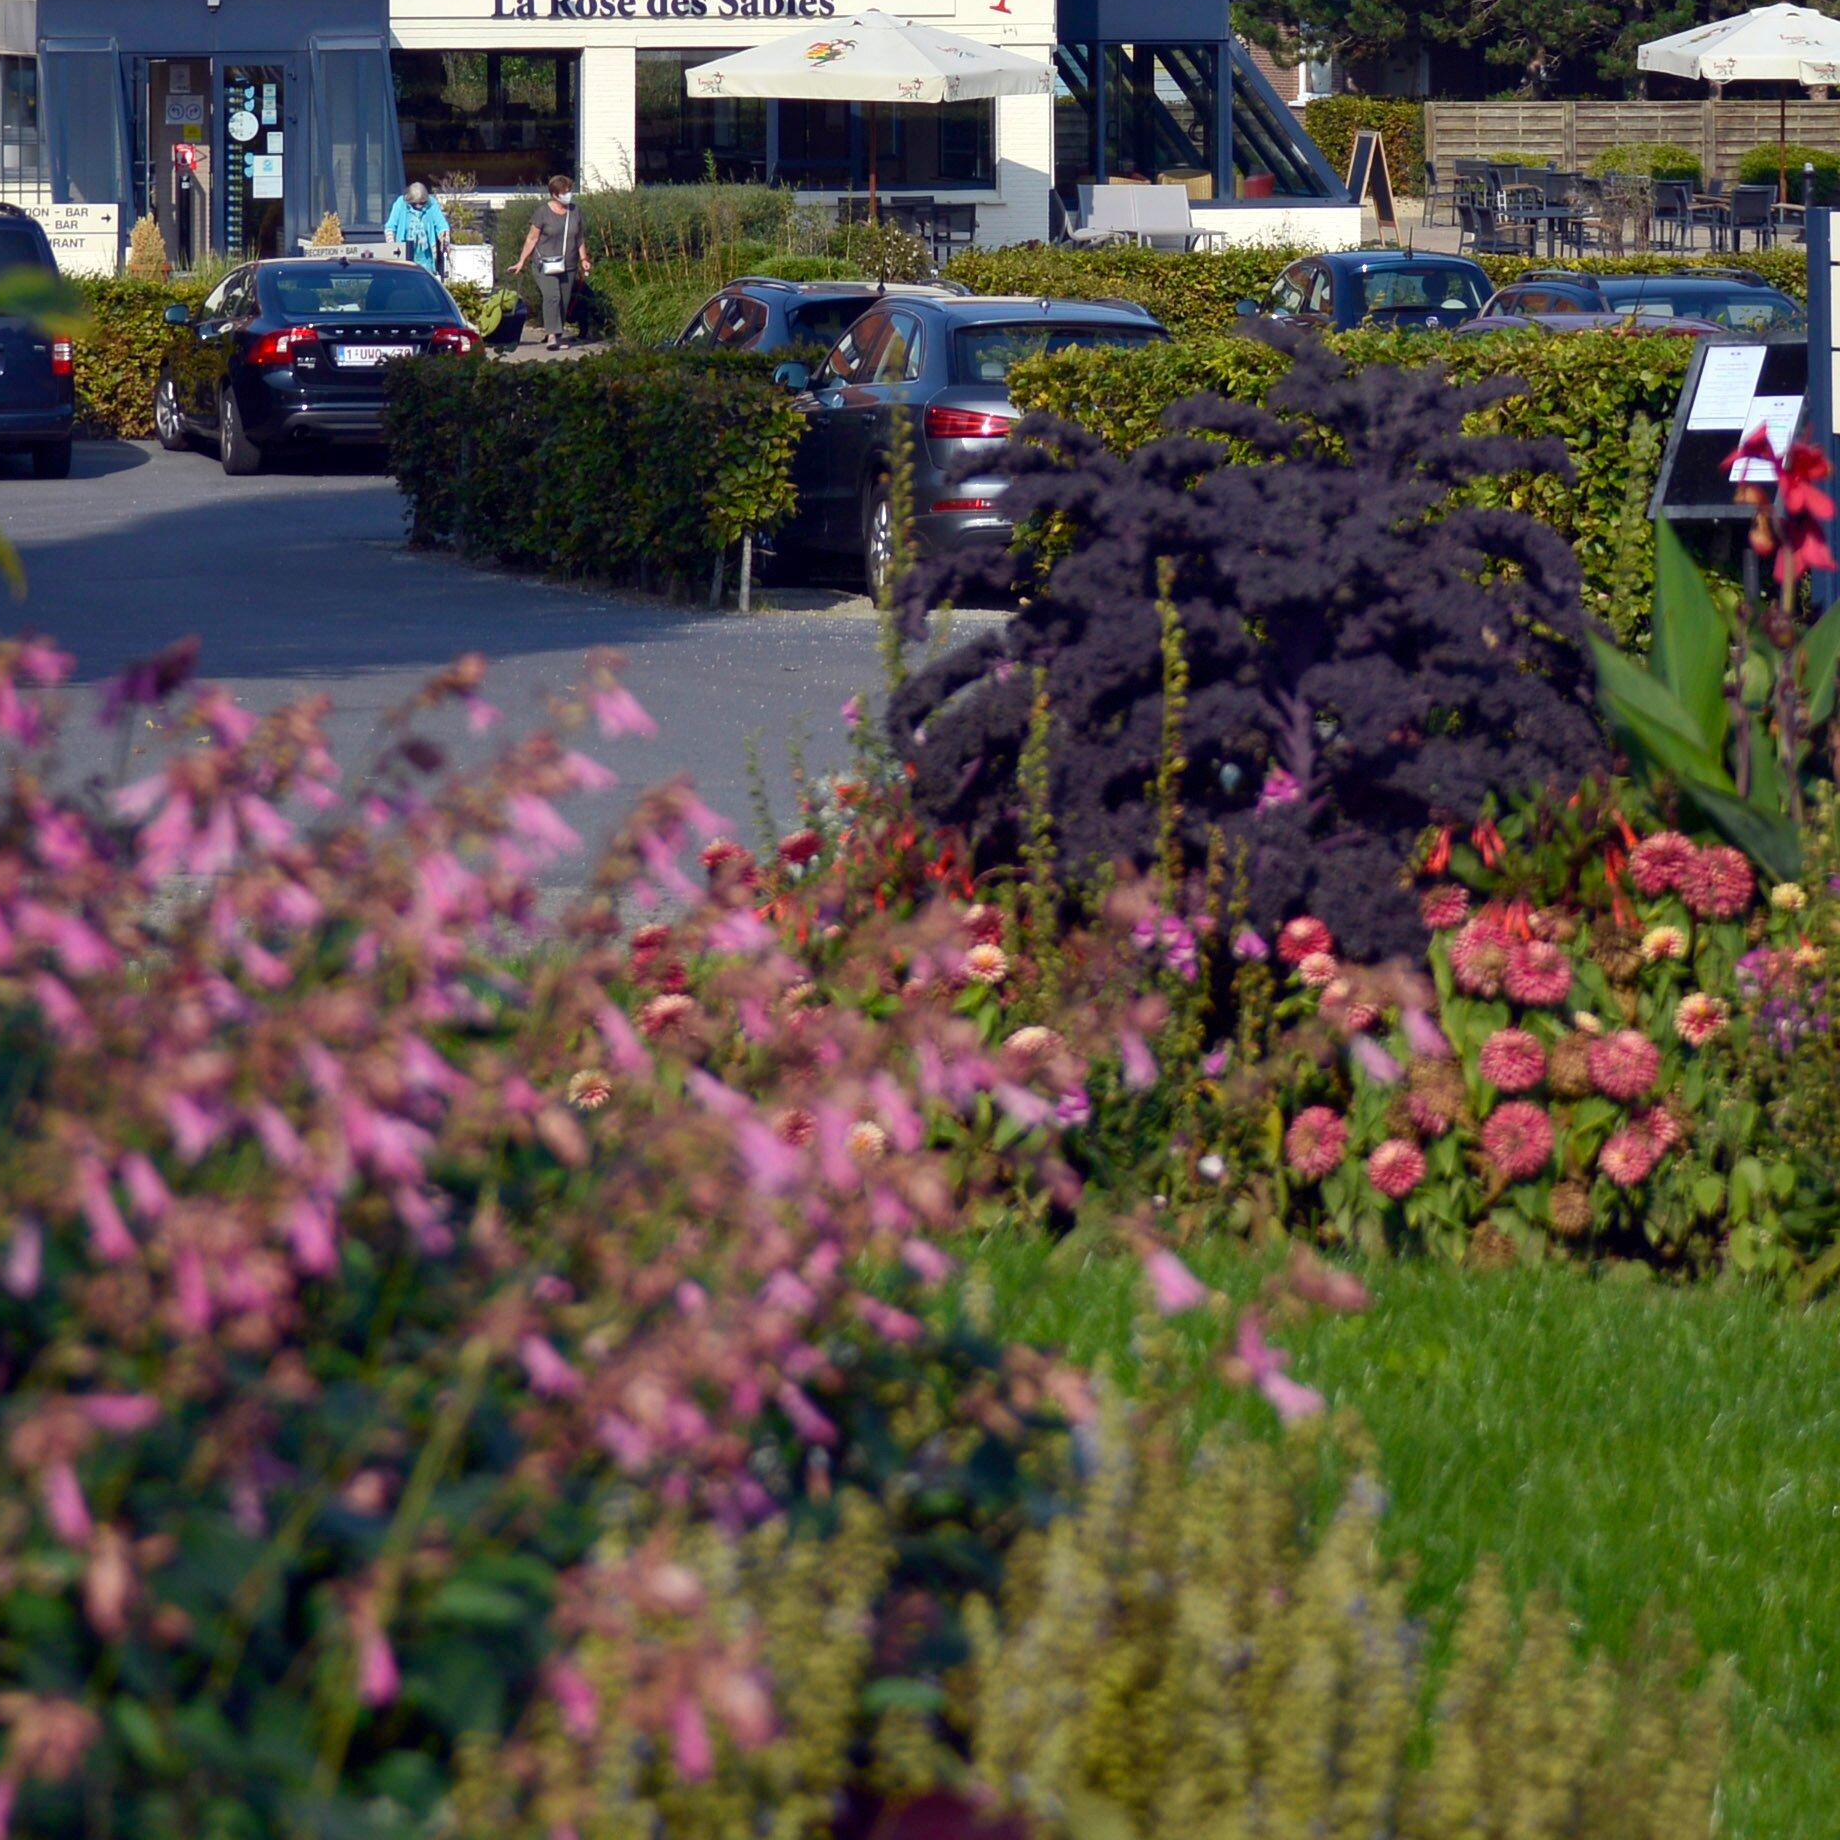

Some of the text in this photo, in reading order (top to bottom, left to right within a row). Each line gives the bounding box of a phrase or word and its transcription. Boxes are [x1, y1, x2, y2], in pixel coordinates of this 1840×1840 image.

[65, 208, 89, 217] BAR
[55, 220, 78, 229] BAR
[304, 248, 338, 257] RECEPTION
[346, 247, 357, 255] BAR
